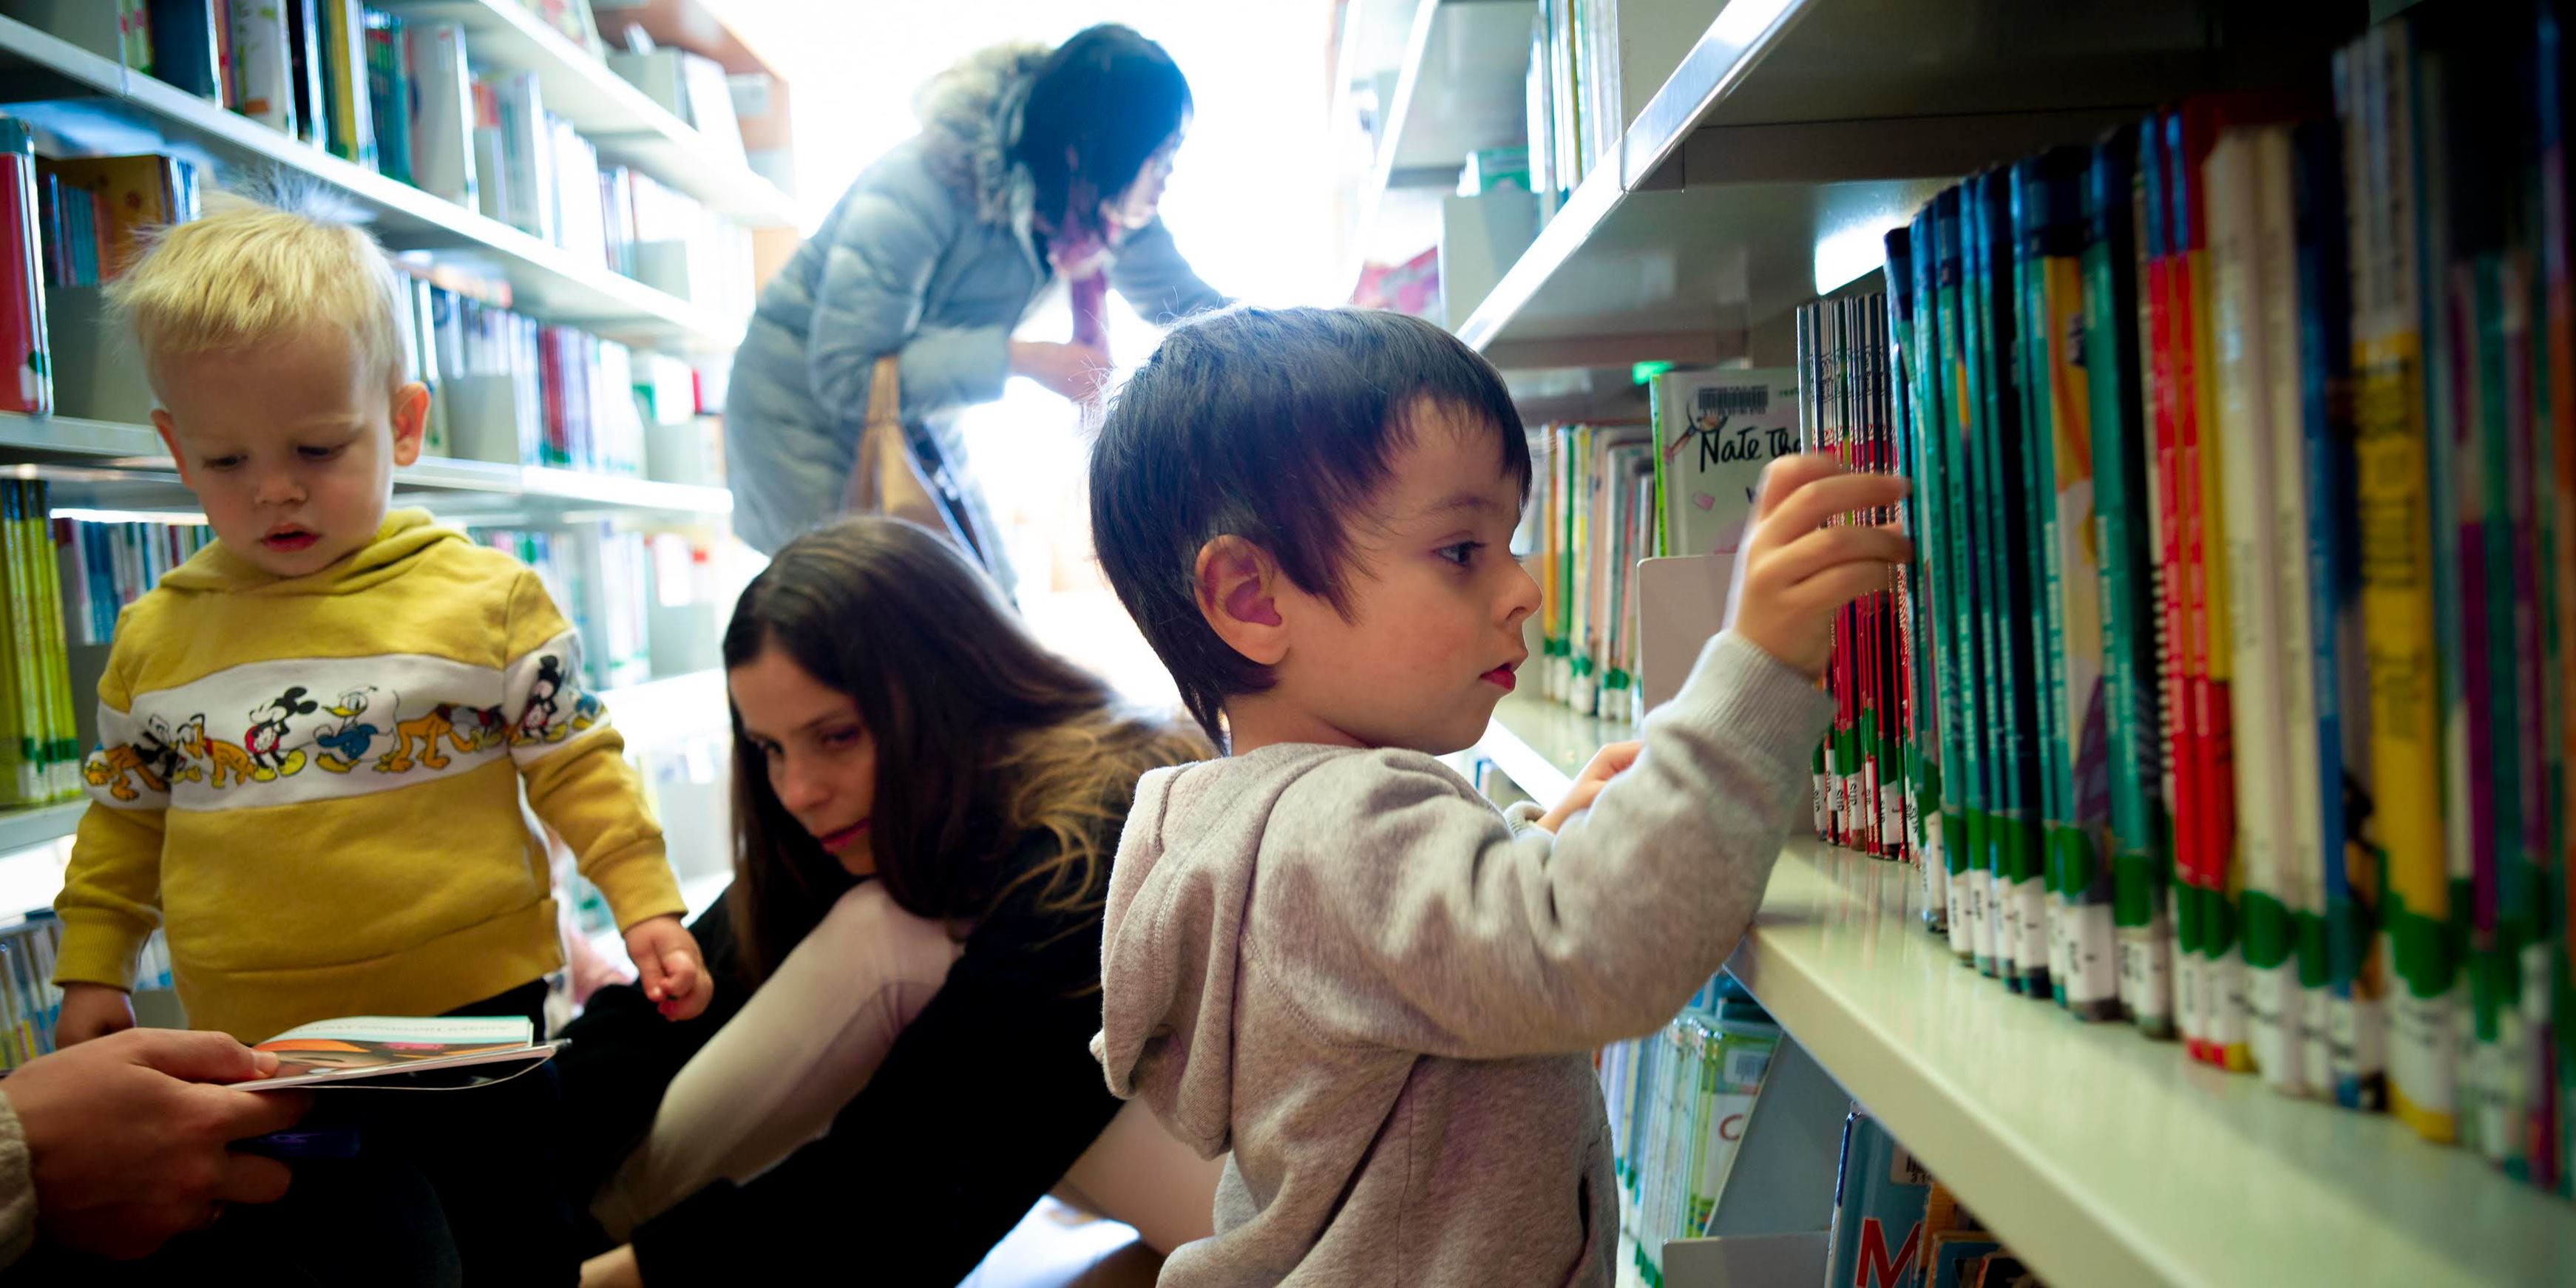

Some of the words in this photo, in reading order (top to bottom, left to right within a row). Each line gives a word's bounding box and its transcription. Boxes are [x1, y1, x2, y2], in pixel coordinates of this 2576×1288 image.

[1700, 425, 1761, 472] Nate
[1837, 789, 1845, 812] SUP
[1849, 782, 1857, 806] SUP
